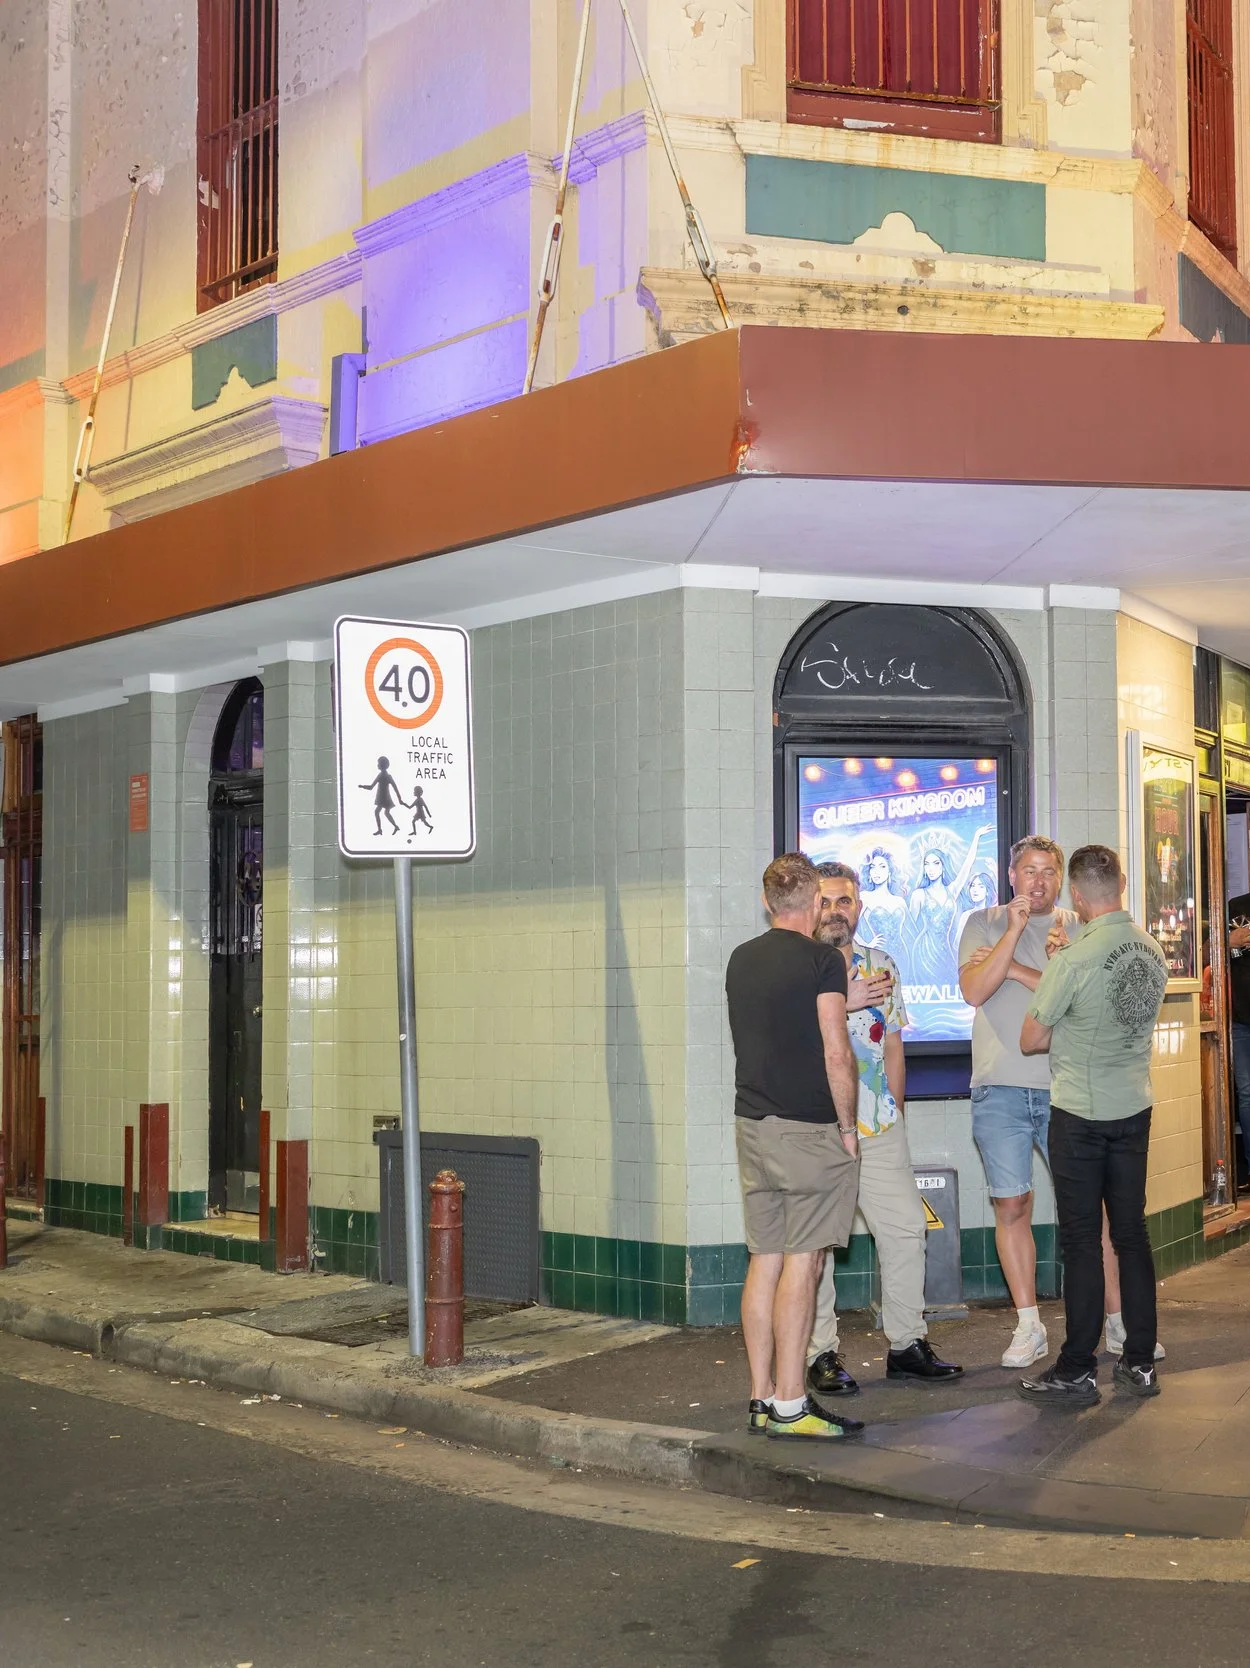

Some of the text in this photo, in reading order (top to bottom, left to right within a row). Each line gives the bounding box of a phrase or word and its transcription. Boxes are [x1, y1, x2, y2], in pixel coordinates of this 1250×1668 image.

[379, 664, 430, 703] 40
[411, 736, 448, 749] LOCAL
[407, 752, 454, 764] TRAFFIC
[415, 768, 447, 780] AREA
[813, 786, 986, 829] QUEER KINGDOM
